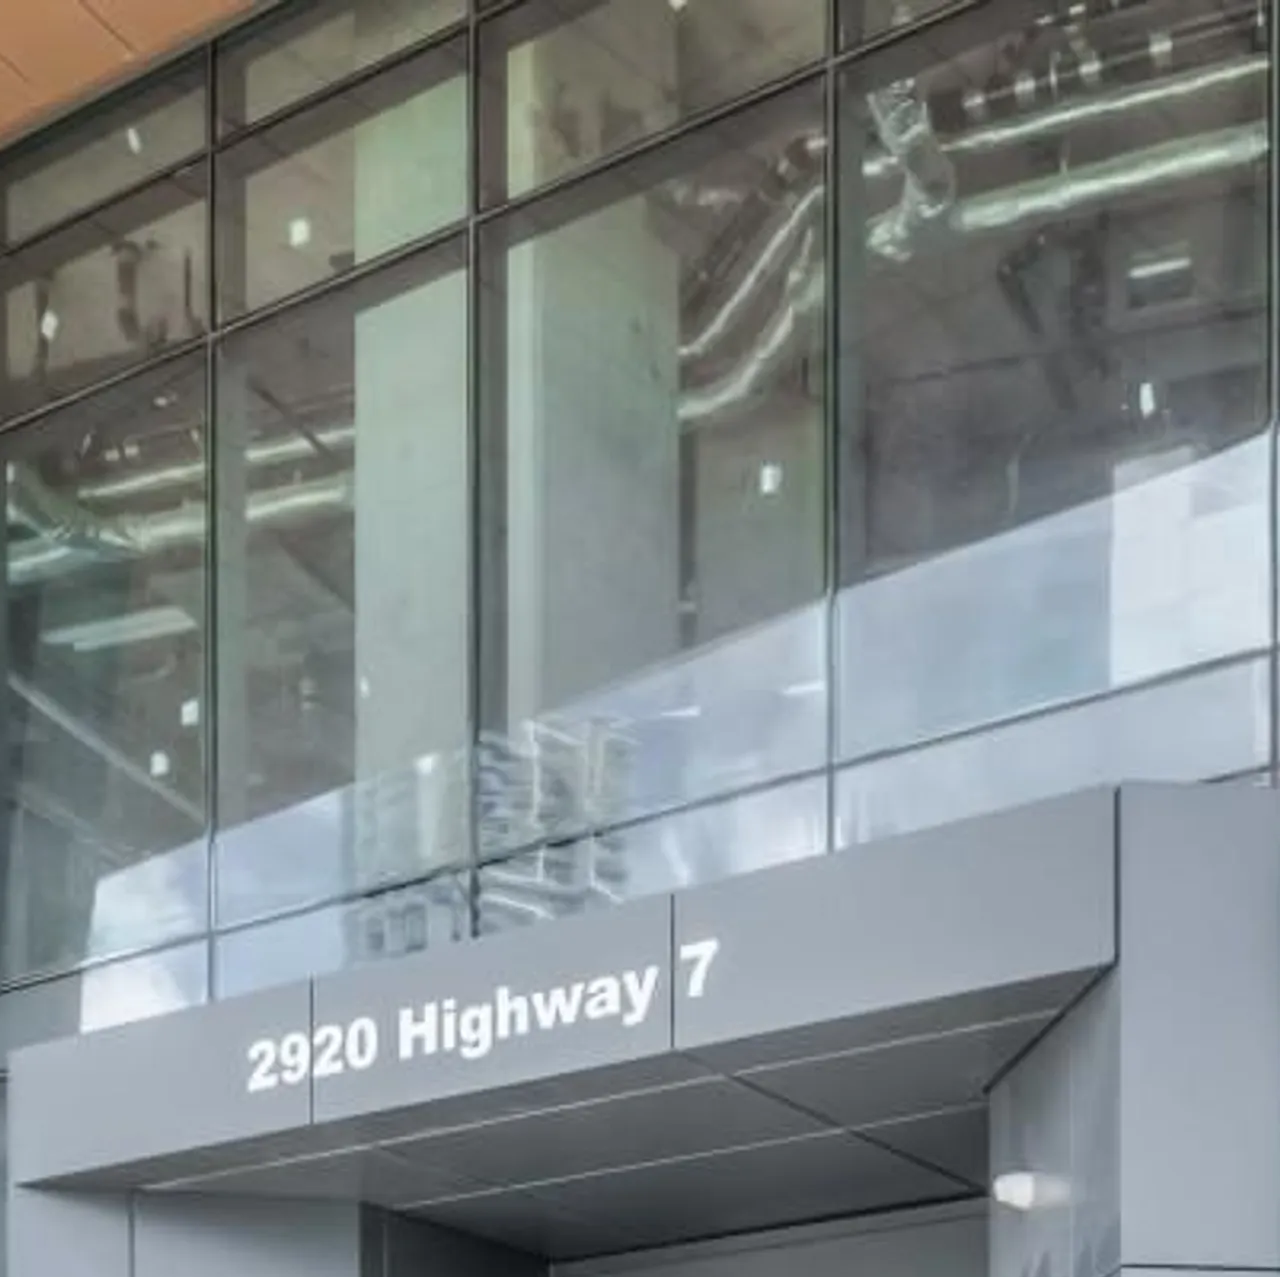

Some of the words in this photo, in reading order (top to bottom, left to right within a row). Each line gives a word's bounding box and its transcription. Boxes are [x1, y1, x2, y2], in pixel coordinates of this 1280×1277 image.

[247, 1017, 378, 1092] 2920
[398, 964, 658, 1062] Highway
[680, 938, 719, 998] 7
